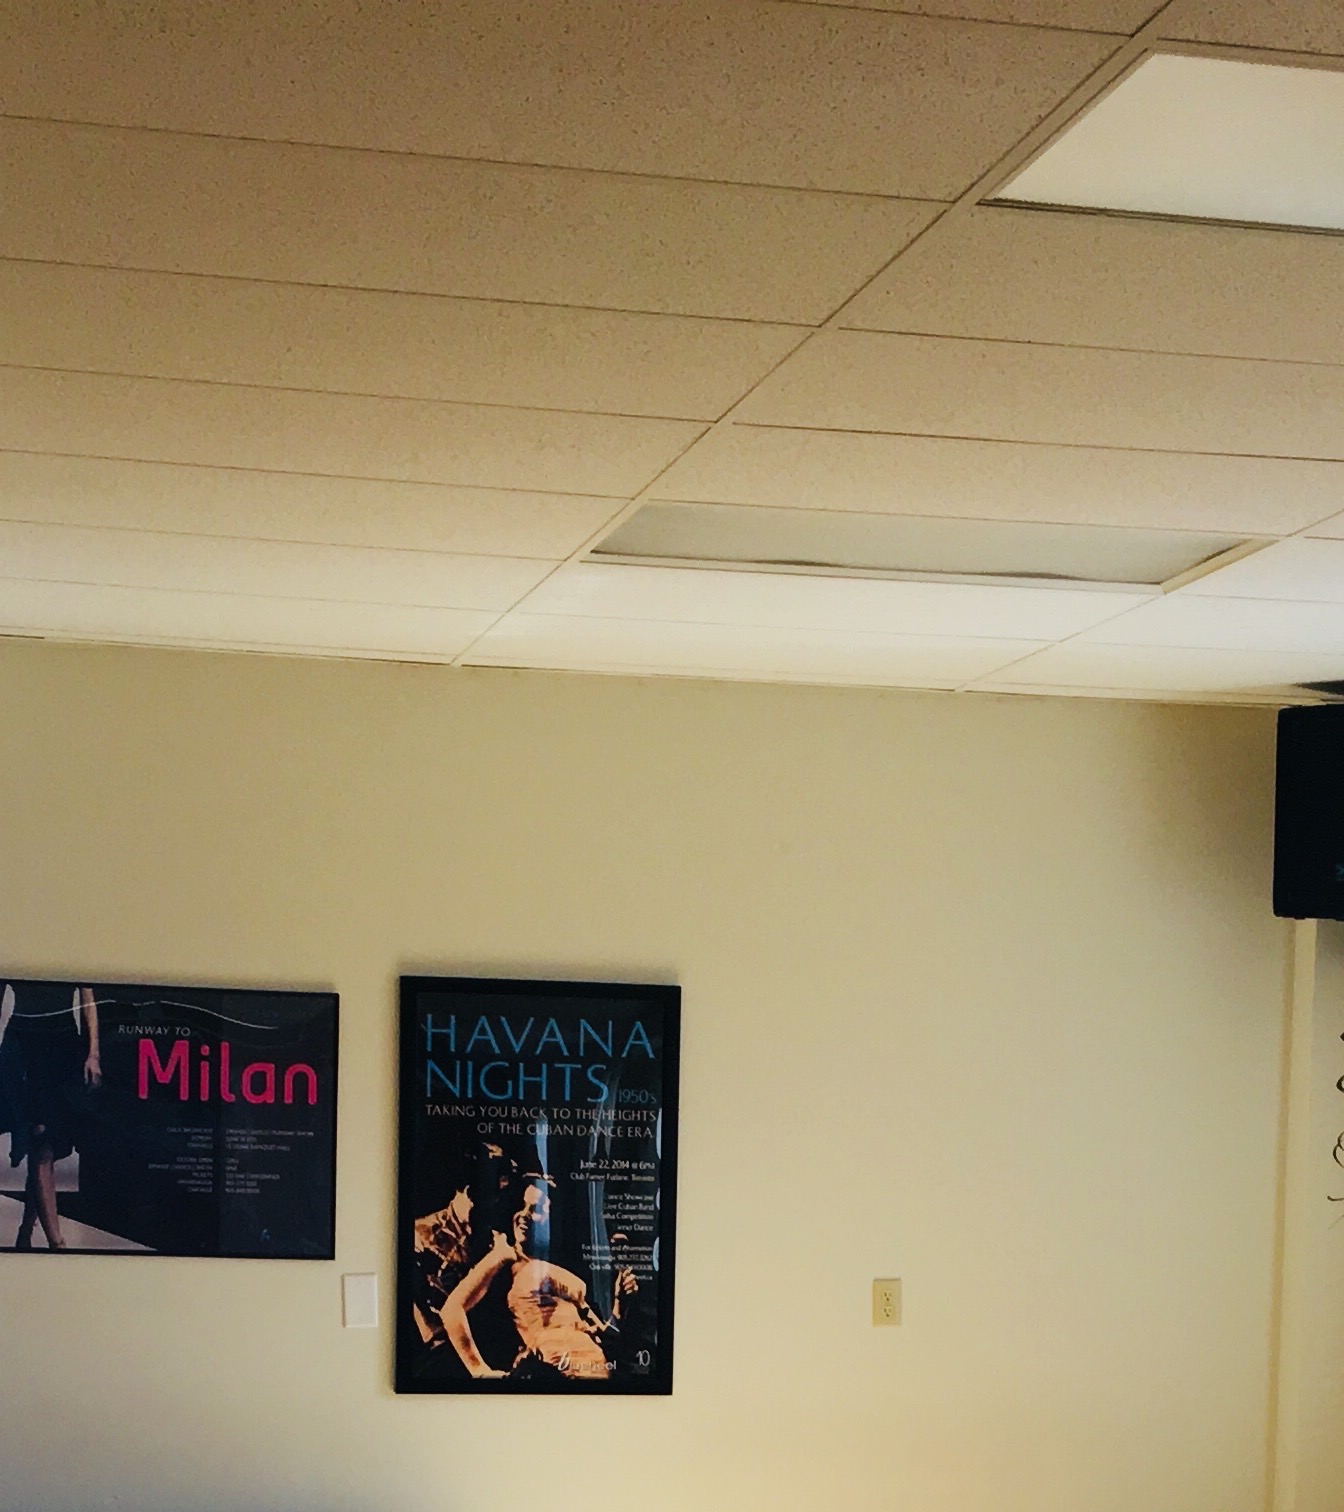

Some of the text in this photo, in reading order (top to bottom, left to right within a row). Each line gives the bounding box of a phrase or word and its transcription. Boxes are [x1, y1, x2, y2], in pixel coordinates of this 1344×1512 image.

[118, 1024, 191, 1037] RUNWAY TO
[425, 1013, 655, 1059] HAVANA
[137, 1038, 319, 1106] Milan
[425, 1059, 609, 1103] NIGHTS
[426, 1104, 657, 1122] TAKING YOU BACK TO THE HEIGHTS
[477, 1122, 494, 1134] OF
[500, 1122, 523, 1135] THE
[527, 1123, 574, 1137] CUBAN
[577, 1125, 624, 1138] DANCE
[636, 1350, 651, 1367] 10
